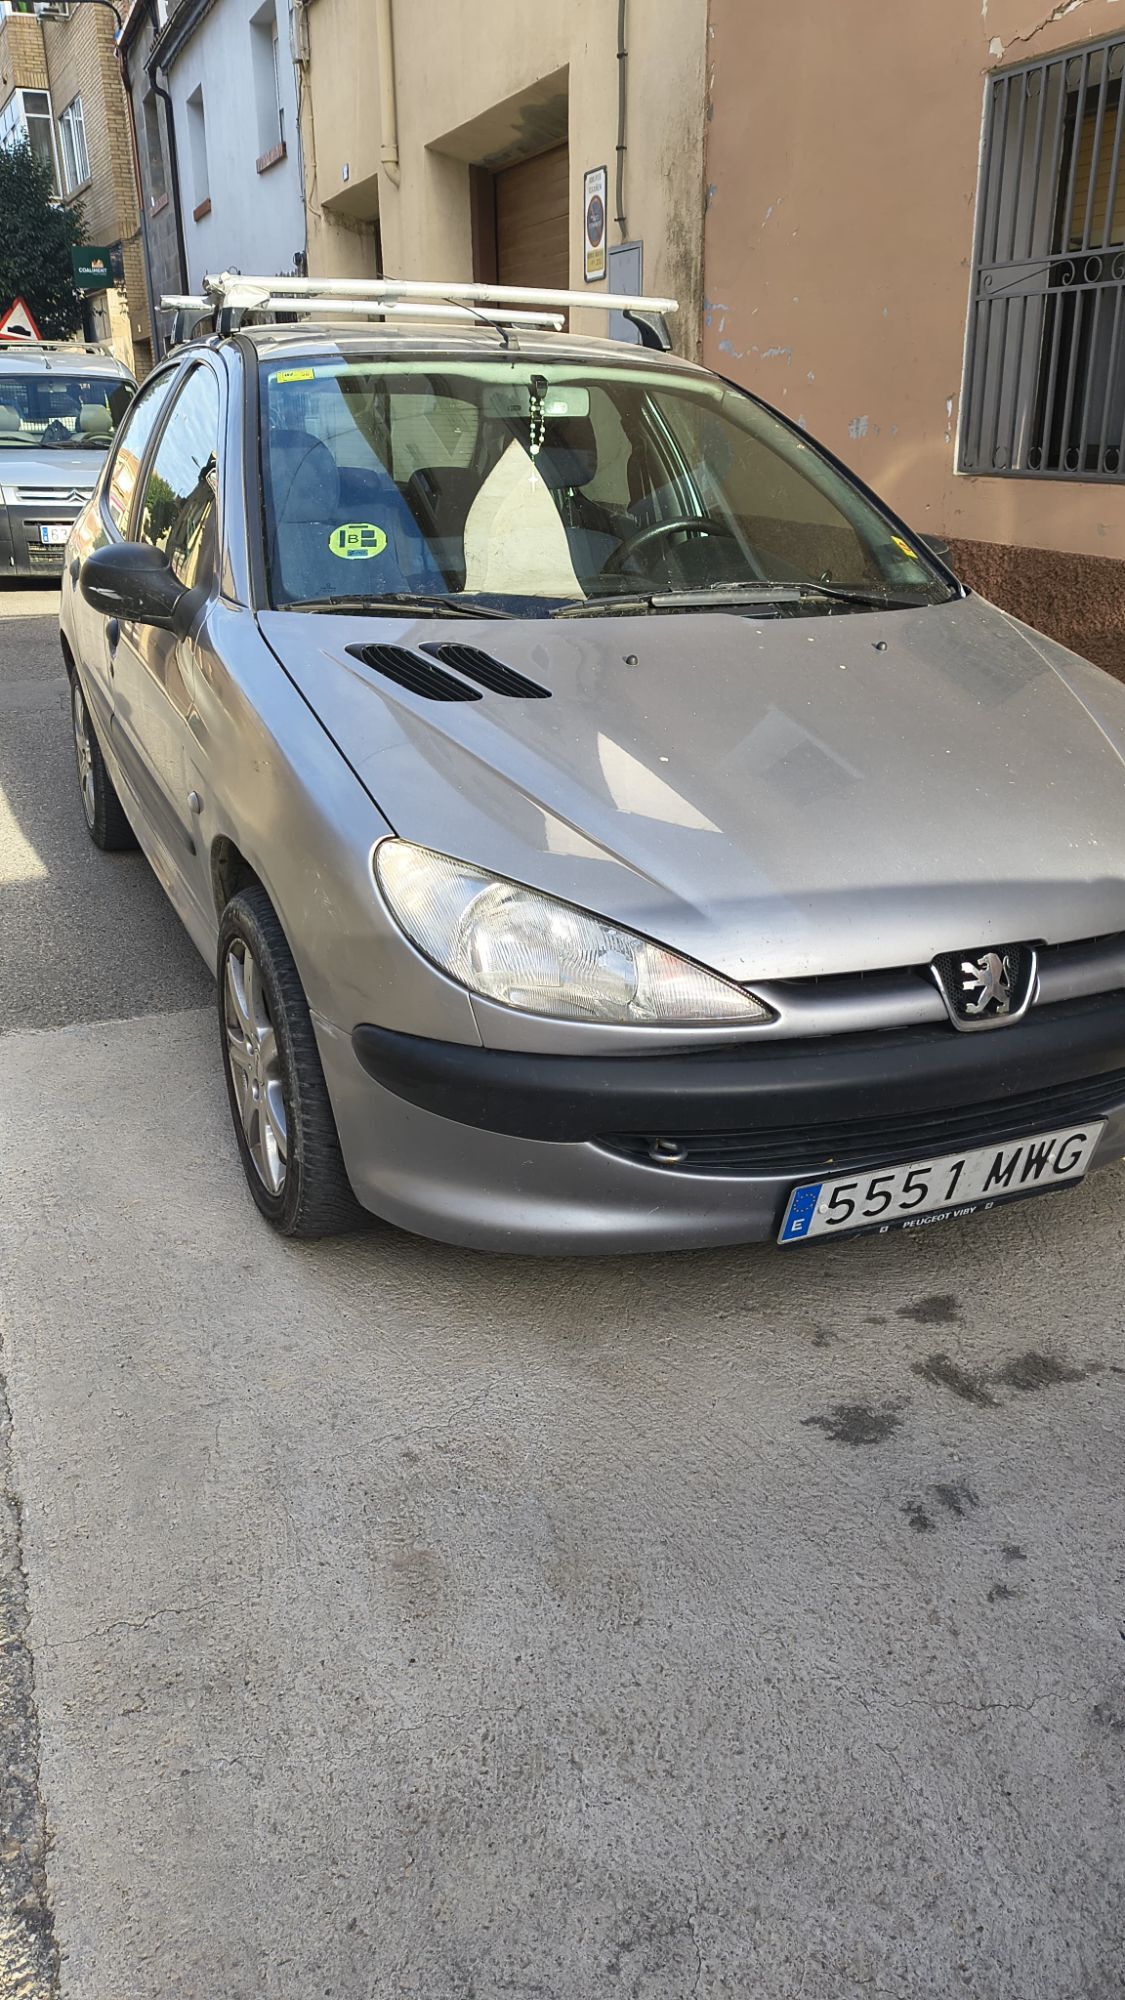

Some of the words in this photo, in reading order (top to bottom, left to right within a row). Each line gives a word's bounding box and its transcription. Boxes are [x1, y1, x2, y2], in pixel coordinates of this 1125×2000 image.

[347, 534, 359, 544] B
[825, 1160, 966, 1225] 5551
[982, 1133, 1088, 1192] MWG
[791, 1218, 805, 1232] E
[902, 1211, 952, 1229] PEUGEOT
[953, 1206, 977, 1218] VIBY
